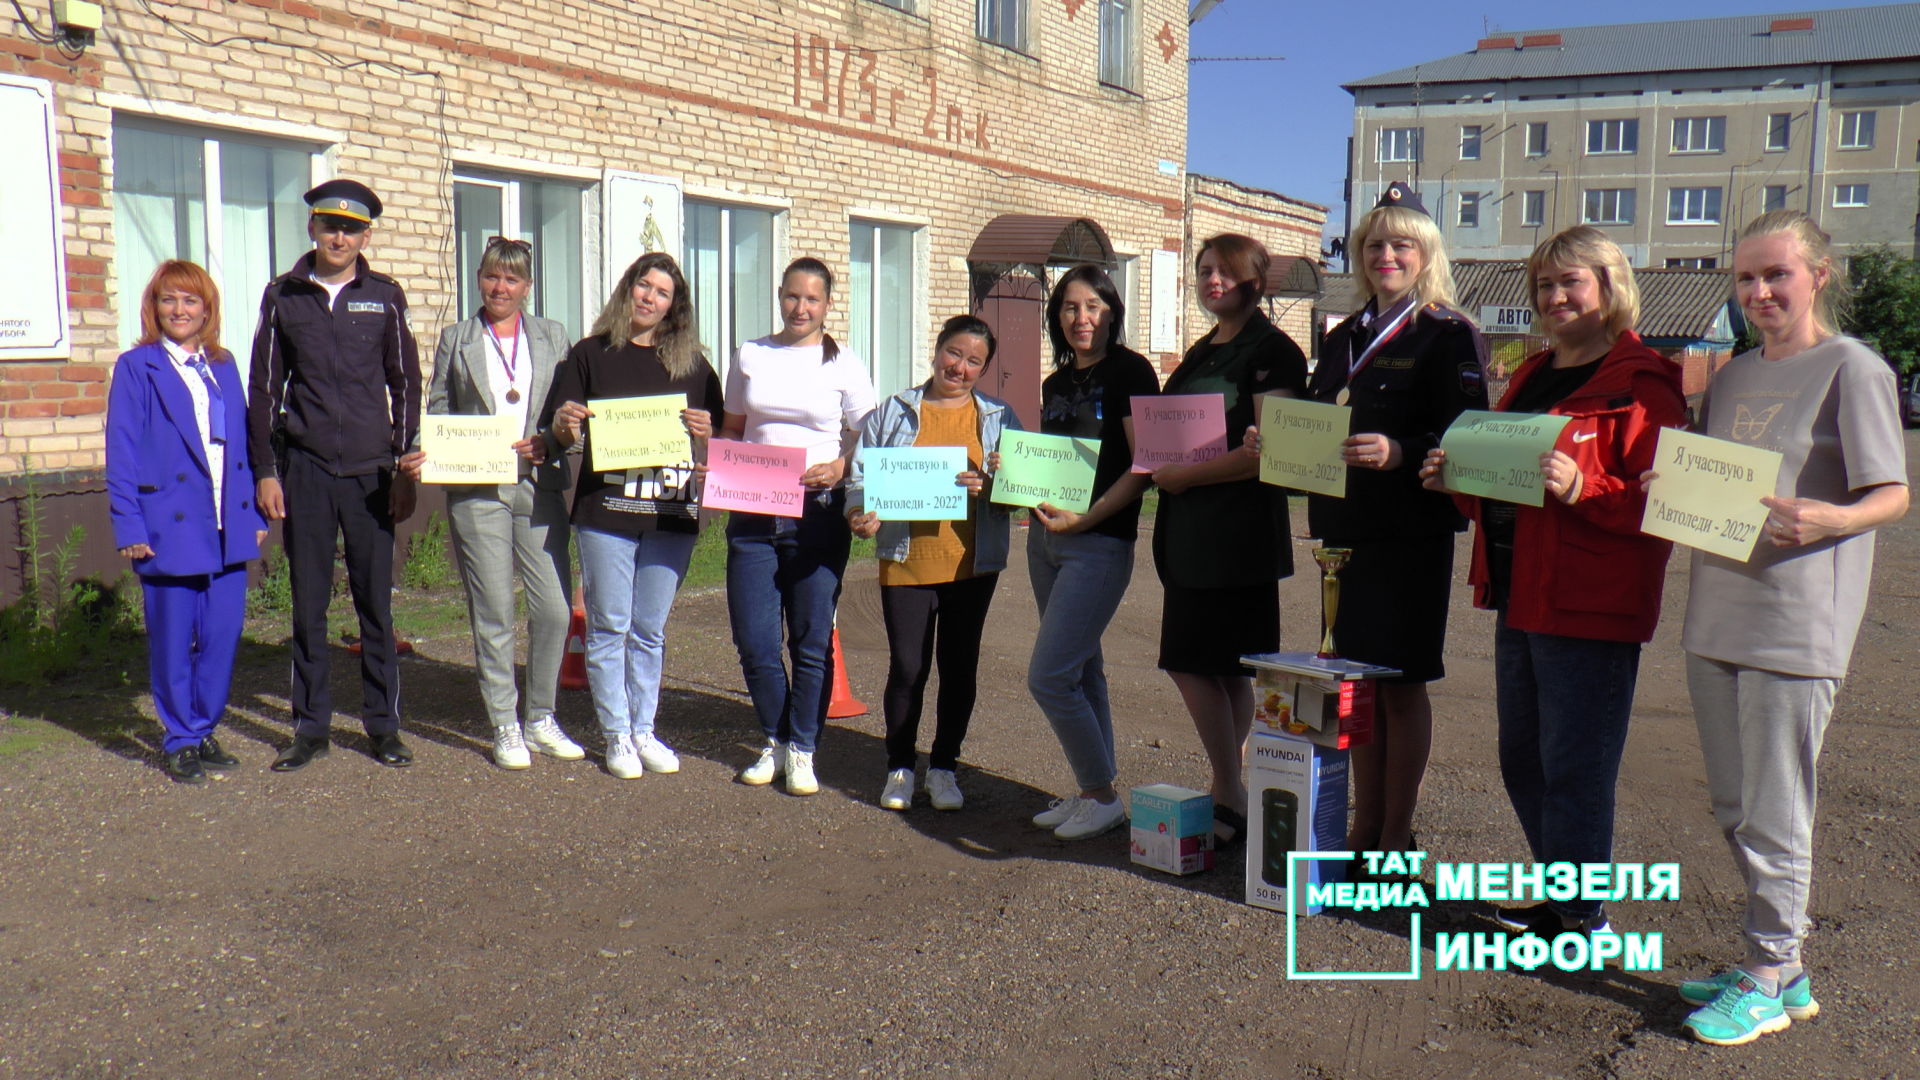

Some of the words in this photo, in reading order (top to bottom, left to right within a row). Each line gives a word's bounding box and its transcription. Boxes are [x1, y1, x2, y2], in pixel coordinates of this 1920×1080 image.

[1498, 308, 1532, 325] АВТО
[604, 408, 612, 421] Я
[615, 408, 661, 424] участвую
[664, 407, 671, 417] в
[1145, 407, 1151, 420] Я
[1153, 409, 1196, 424] участвую
[1199, 409, 1206, 420] в
[1274, 409, 1281, 424] Я
[1282, 414, 1325, 434] участвую
[1326, 421, 1332, 433] в
[436, 424, 443, 437] Я
[446, 428, 493, 440] участвую
[495, 428, 501, 437] в
[1466, 418, 1481, 430] Я
[1474, 421, 1531, 438] участвую
[1531, 426, 1541, 437] в
[723, 449, 731, 461] Я
[733, 454, 780, 468] участвую
[782, 458, 788, 467] в
[1014, 441, 1024, 454] Я
[1024, 445, 1073, 462] участвую
[1074, 453, 1081, 462] в
[880, 458, 887, 471] Я
[891, 460, 940, 474] участвую
[942, 460, 948, 470] в
[1673, 446, 1686, 465] Я
[1685, 453, 1744, 482] участвую
[1746, 467, 1754, 482] в
[1256, 747, 1305, 763] HYUNDAI
[1256, 888, 1268, 898] 50
[1270, 890, 1282, 901] Вт
